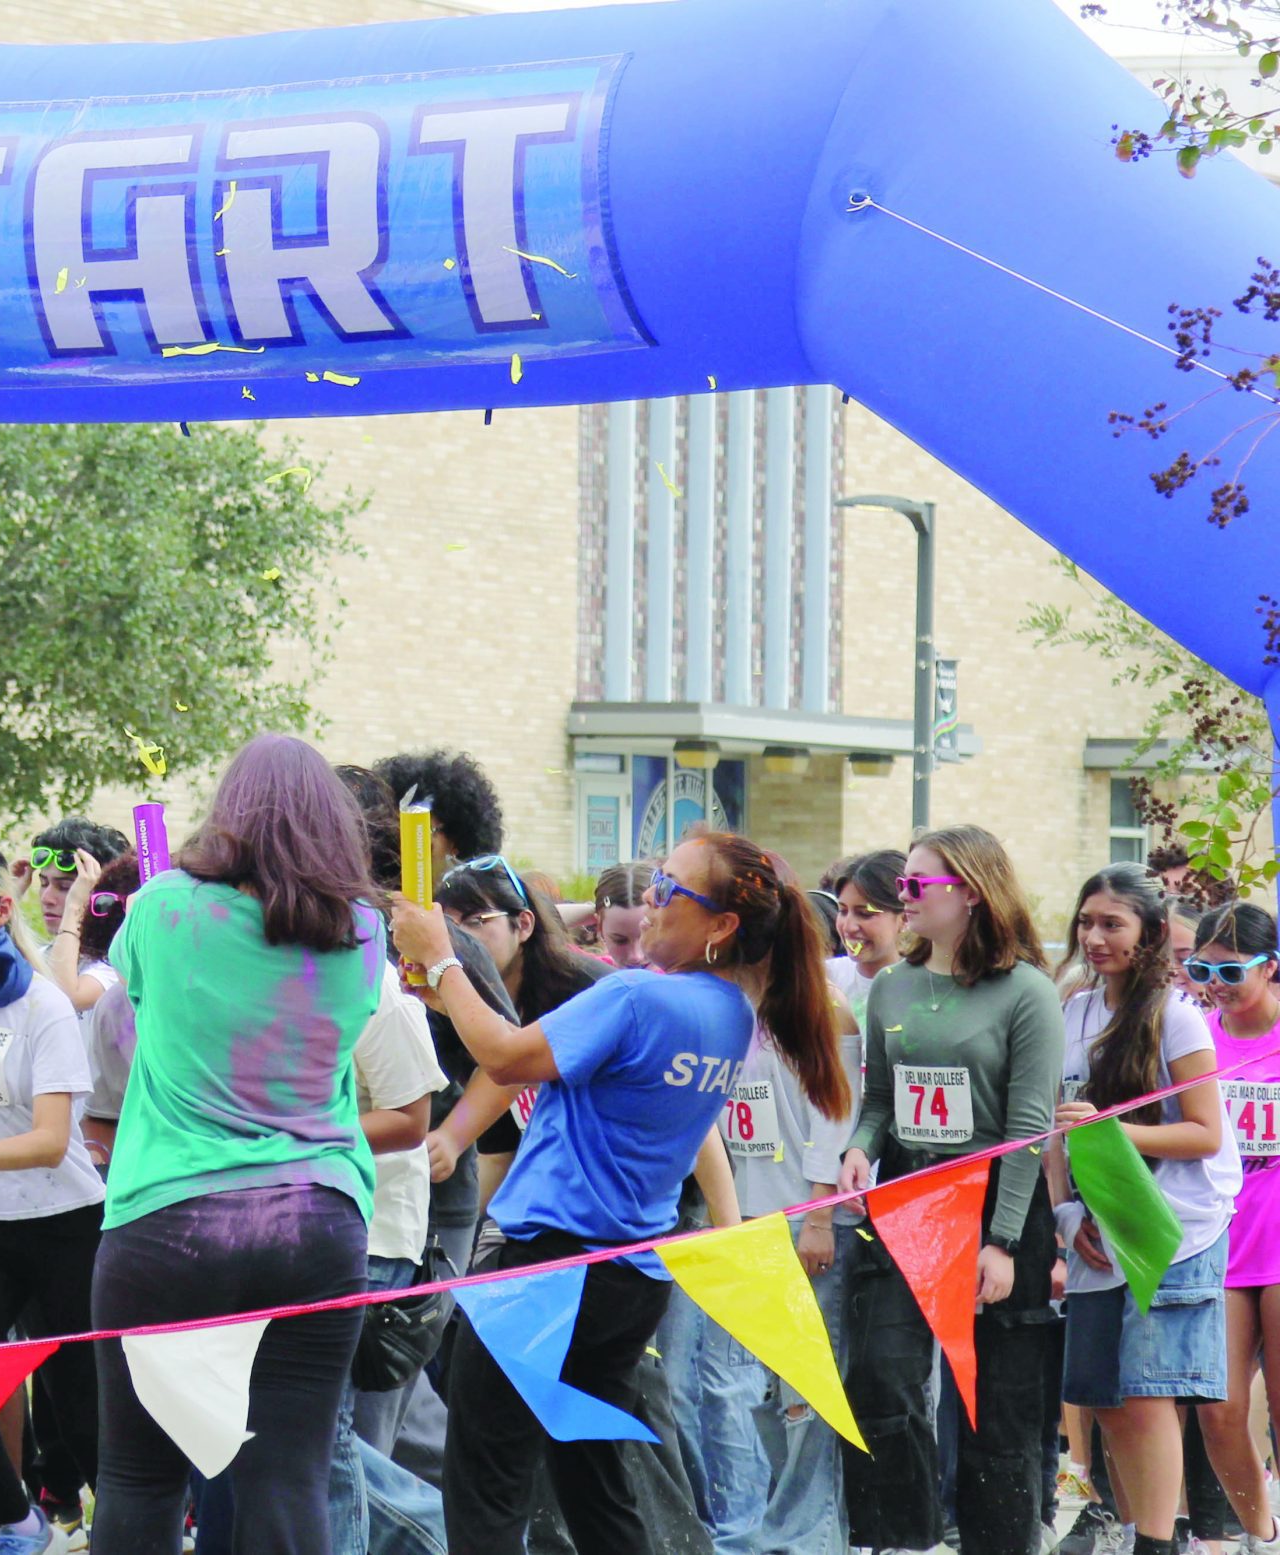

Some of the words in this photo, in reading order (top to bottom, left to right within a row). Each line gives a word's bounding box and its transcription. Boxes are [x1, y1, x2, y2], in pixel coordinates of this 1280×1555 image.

[139, 819, 149, 857] CANNON
[416, 824, 424, 860] CANNON
[905, 1071, 916, 1084] DEL
[917, 1071, 932, 1085] MAR
[933, 1072, 965, 1086] COLLEGE
[739, 1086, 769, 1100] COLLEGE
[1227, 1085, 1237, 1098] DEL
[1239, 1086, 1255, 1100] MAR
[909, 1085, 948, 1126] 74
[725, 1099, 754, 1141] 78
[901, 1126, 939, 1138] INTRAMURAL
[940, 1129, 969, 1139] SPORTS
[748, 1142, 775, 1153] SPORTS
